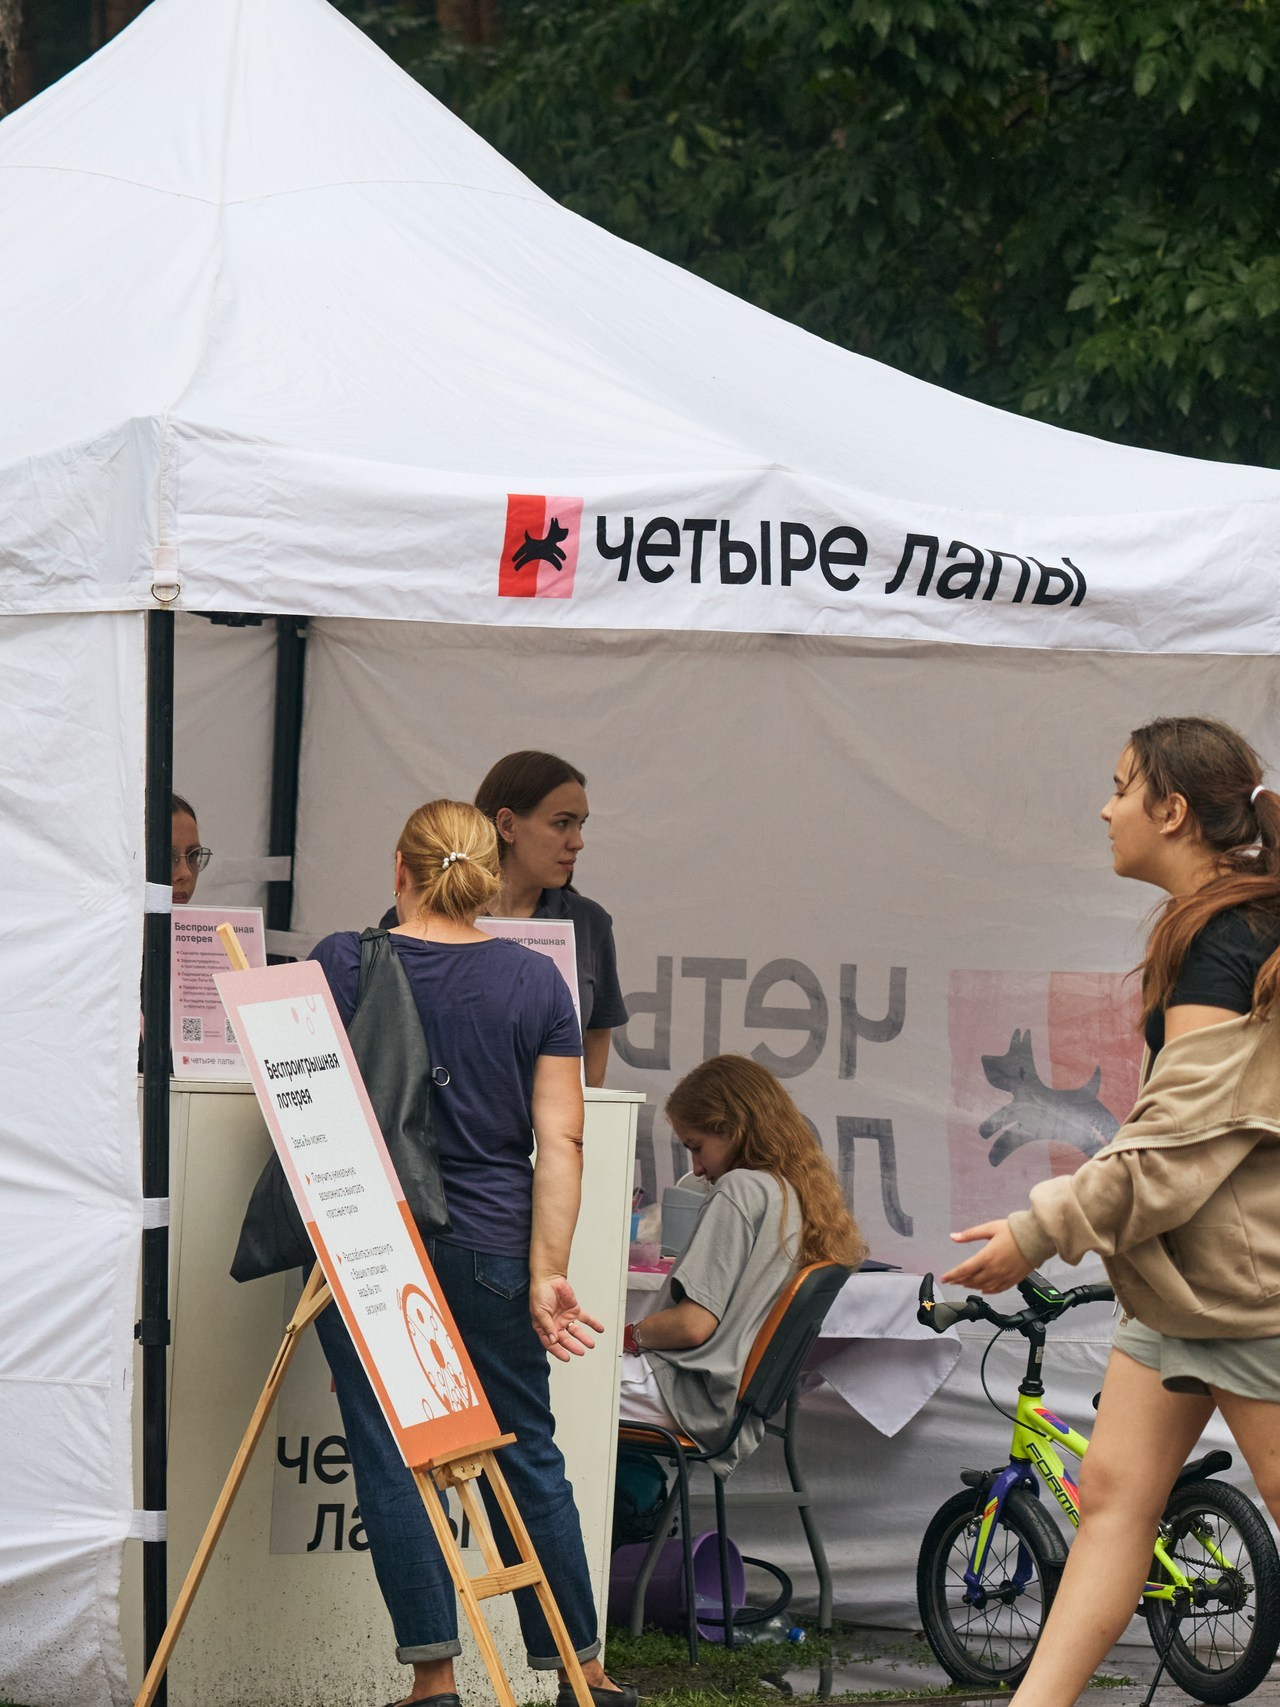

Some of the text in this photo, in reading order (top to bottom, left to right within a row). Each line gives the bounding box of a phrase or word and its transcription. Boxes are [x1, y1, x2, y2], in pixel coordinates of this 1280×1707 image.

[174, 922, 255, 934] Беспроигшная
[175, 934, 213, 944] лотерея
[263, 1052, 341, 1082] Беспроигрышная
[276, 1088, 313, 1111] лотерея
[1026, 1442, 1080, 1528] FORMA
